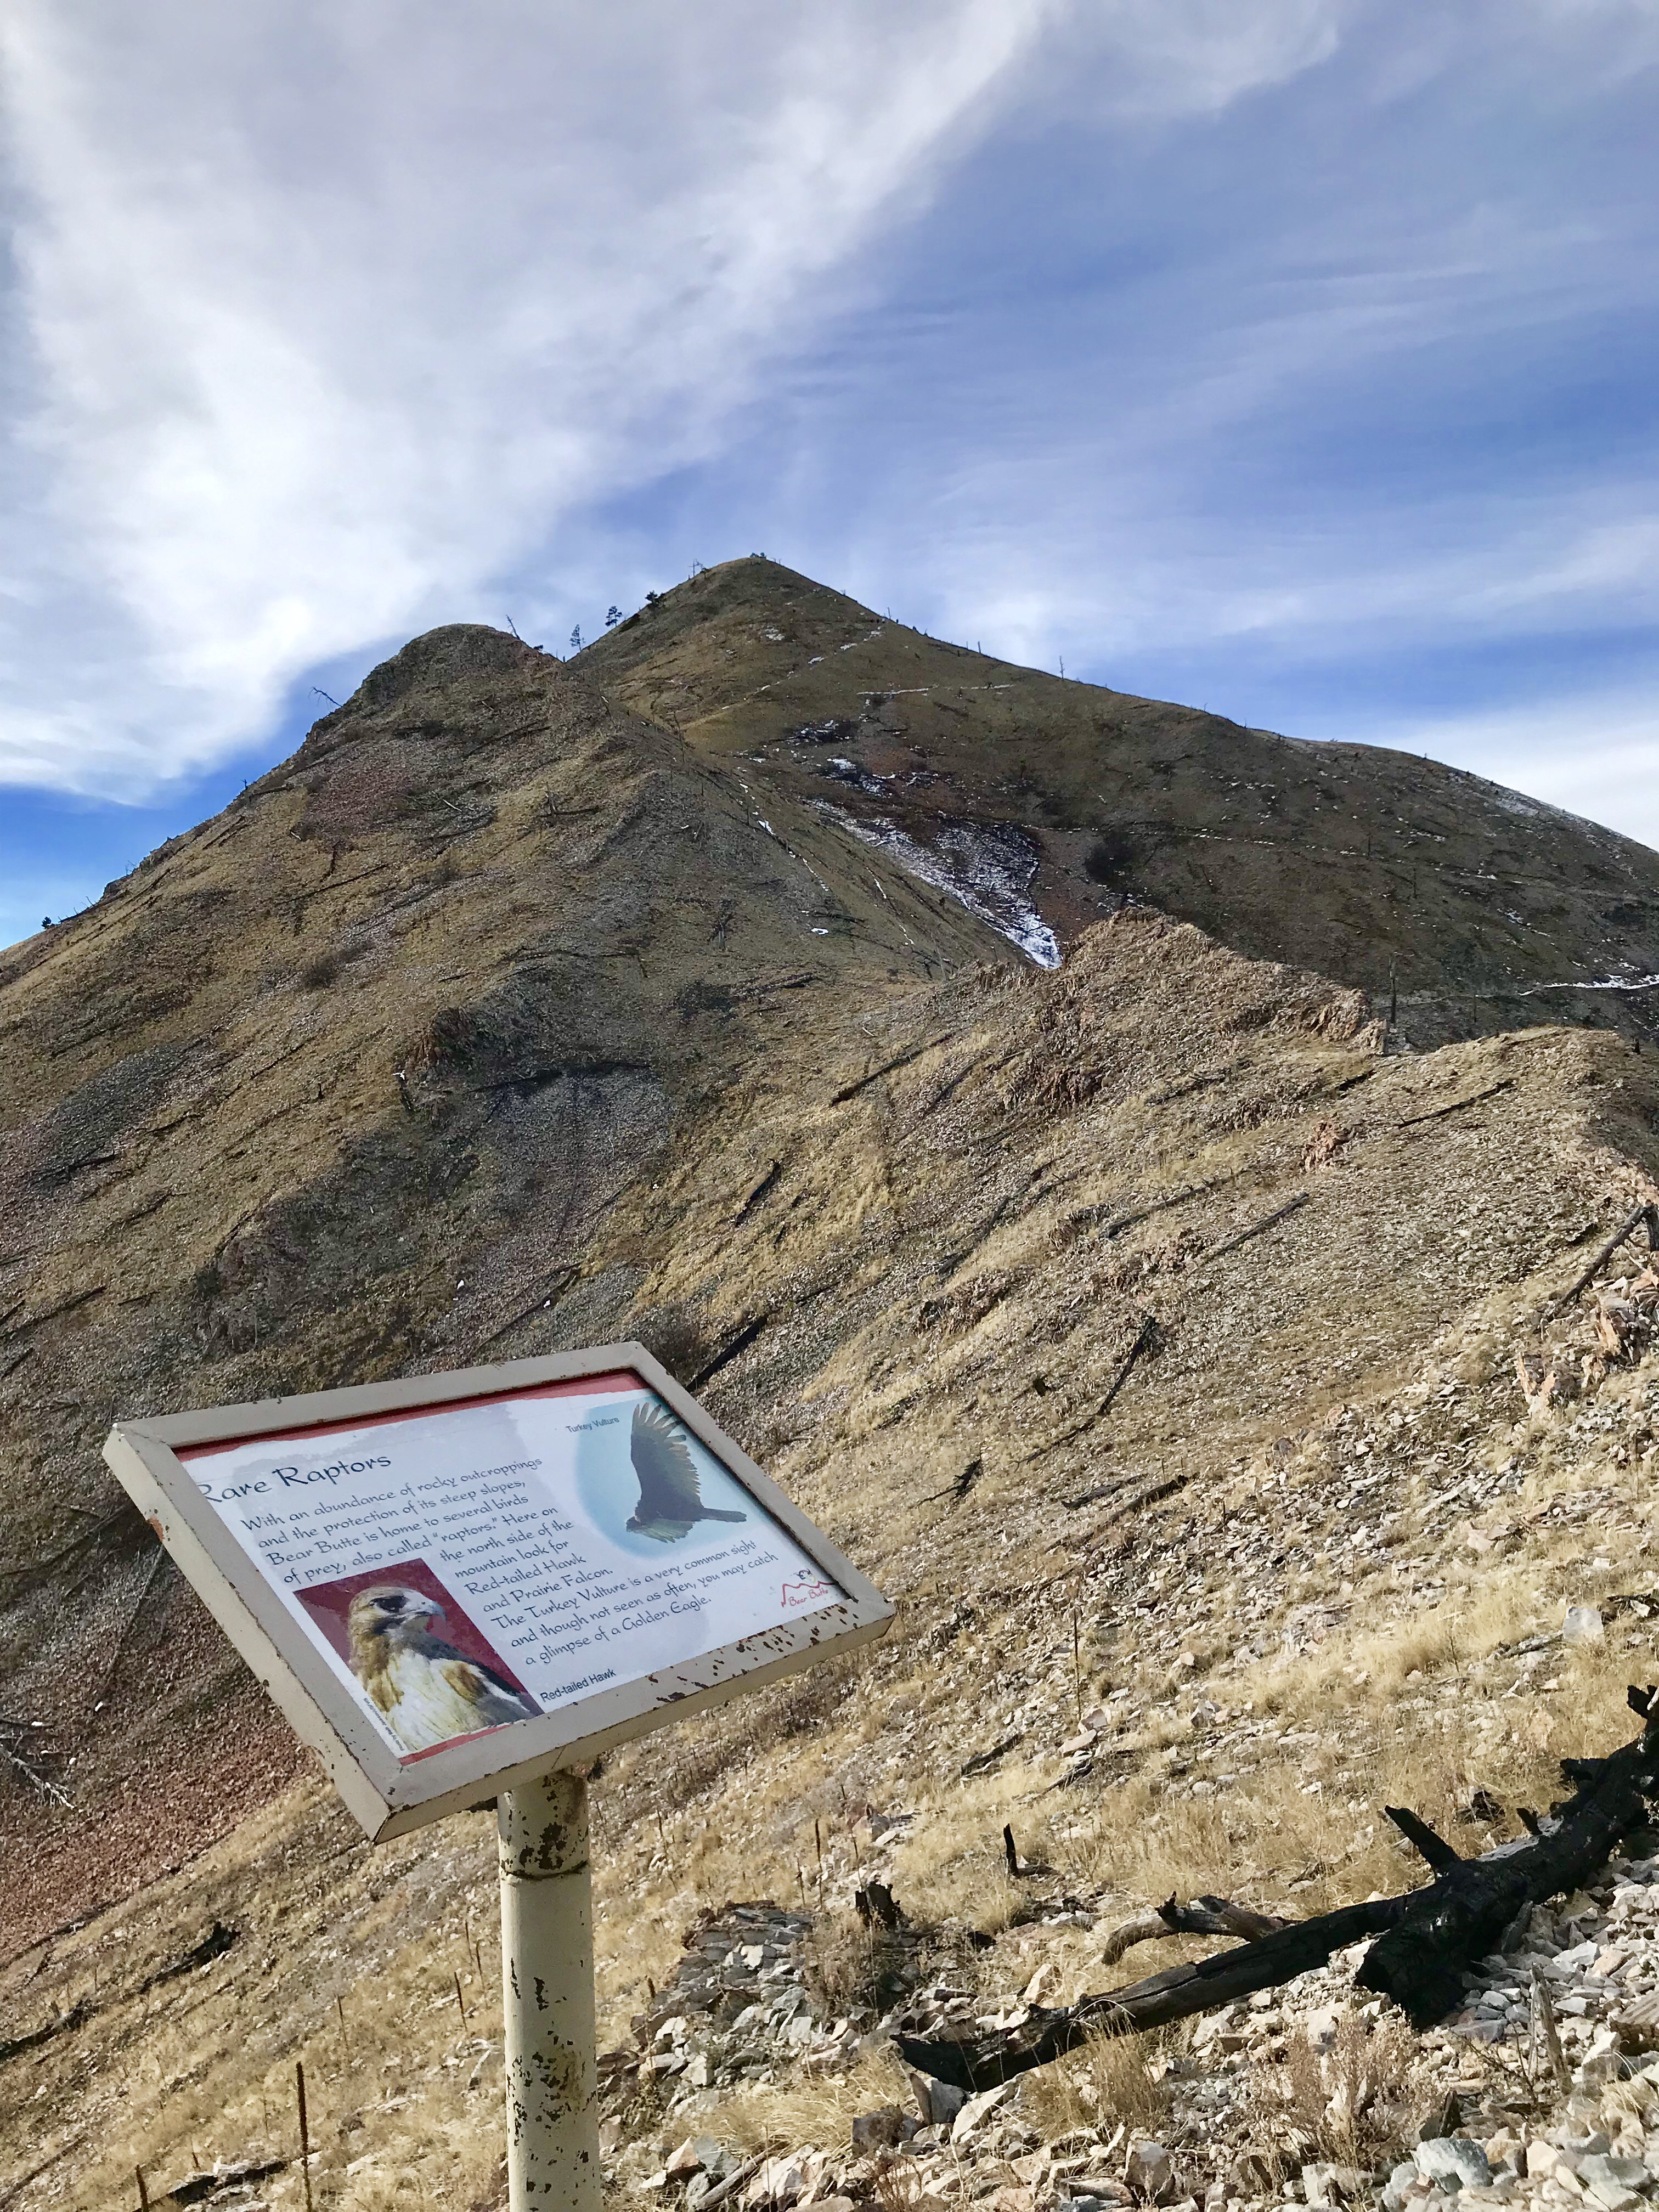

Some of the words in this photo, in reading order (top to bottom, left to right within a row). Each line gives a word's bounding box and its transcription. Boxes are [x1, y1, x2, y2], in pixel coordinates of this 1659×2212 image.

[565, 1423, 592, 1432] Turkey
[592, 1418, 620, 1427] Vulture
[197, 1481, 272, 1502] Rare
[272, 1456, 391, 1487] Raptors
[240, 1513, 285, 1531] With
[289, 1511, 310, 1521] an
[314, 1491, 396, 1515] abundance
[400, 1482, 416, 1497] of
[417, 1476, 458, 1492] rocky
[460, 1458, 543, 1482] outcroppings
[258, 1531, 289, 1548] and
[292, 1527, 320, 1539] the
[323, 1508, 398, 1536] protection
[402, 1500, 419, 1515] of
[417, 1499, 437, 1510] its
[440, 1490, 476, 1505] steep
[480, 1481, 526, 1495] slopes,
[266, 1549, 314, 1565] Bear
[314, 1537, 363, 1553] Butte
[365, 1532, 379, 1542] is
[378, 1523, 422, 1538] home
[424, 1518, 439, 1527] to
[443, 1501, 493, 1522] several
[492, 1494, 529, 1510] birds
[284, 1568, 302, 1585] of
[304, 1563, 347, 1582] prey,
[352, 1551, 382, 1566] also
[388, 1534, 433, 1557] called
[501, 1512, 539, 1527] Here
[542, 1507, 558, 1516] on
[440, 1549, 465, 1562] the
[467, 1537, 505, 1555] north
[507, 1529, 535, 1544] side
[538, 1521, 554, 1537] of
[552, 1519, 574, 1530] the
[454, 1555, 518, 1578] mountain
[516, 1544, 550, 1560] look
[549, 1539, 569, 1554] for
[464, 1564, 543, 1595] Red-tailed
[544, 1553, 586, 1573] Hawk
[483, 1594, 511, 1612] and
[509, 1582, 563, 1602] Prairie
[561, 1568, 614, 1587] Falcon.
[490, 1614, 527, 1629] The
[523, 1598, 580, 1618] Turkey
[577, 1579, 629, 1601] Vulture
[628, 1578, 641, 1586] is
[656, 1566, 684, 1580] very
[684, 1550, 730, 1570] common
[731, 1539, 757, 1556] sight
[788, 1596, 808, 1606] Bear
[808, 1588, 828, 1599] Butte
[511, 1628, 540, 1647] and
[540, 1613, 589, 1637] though
[589, 1606, 611, 1621] not
[613, 1596, 644, 1613] seen
[646, 1592, 662, 1602] as
[664, 1582, 696, 1598] often,
[697, 1574, 720, 1588] you
[721, 1564, 747, 1577] may
[748, 1550, 779, 1569] catch
[526, 1656, 536, 1665] a
[539, 1637, 591, 1664] glimpse
[594, 1626, 611, 1641] of
[611, 1627, 622, 1635] a
[622, 1609, 670, 1630] Golden
[670, 1594, 712, 1614] Eagle.
[540, 1677, 589, 1702] Red-tailed
[588, 1668, 617, 1684] Hawk
